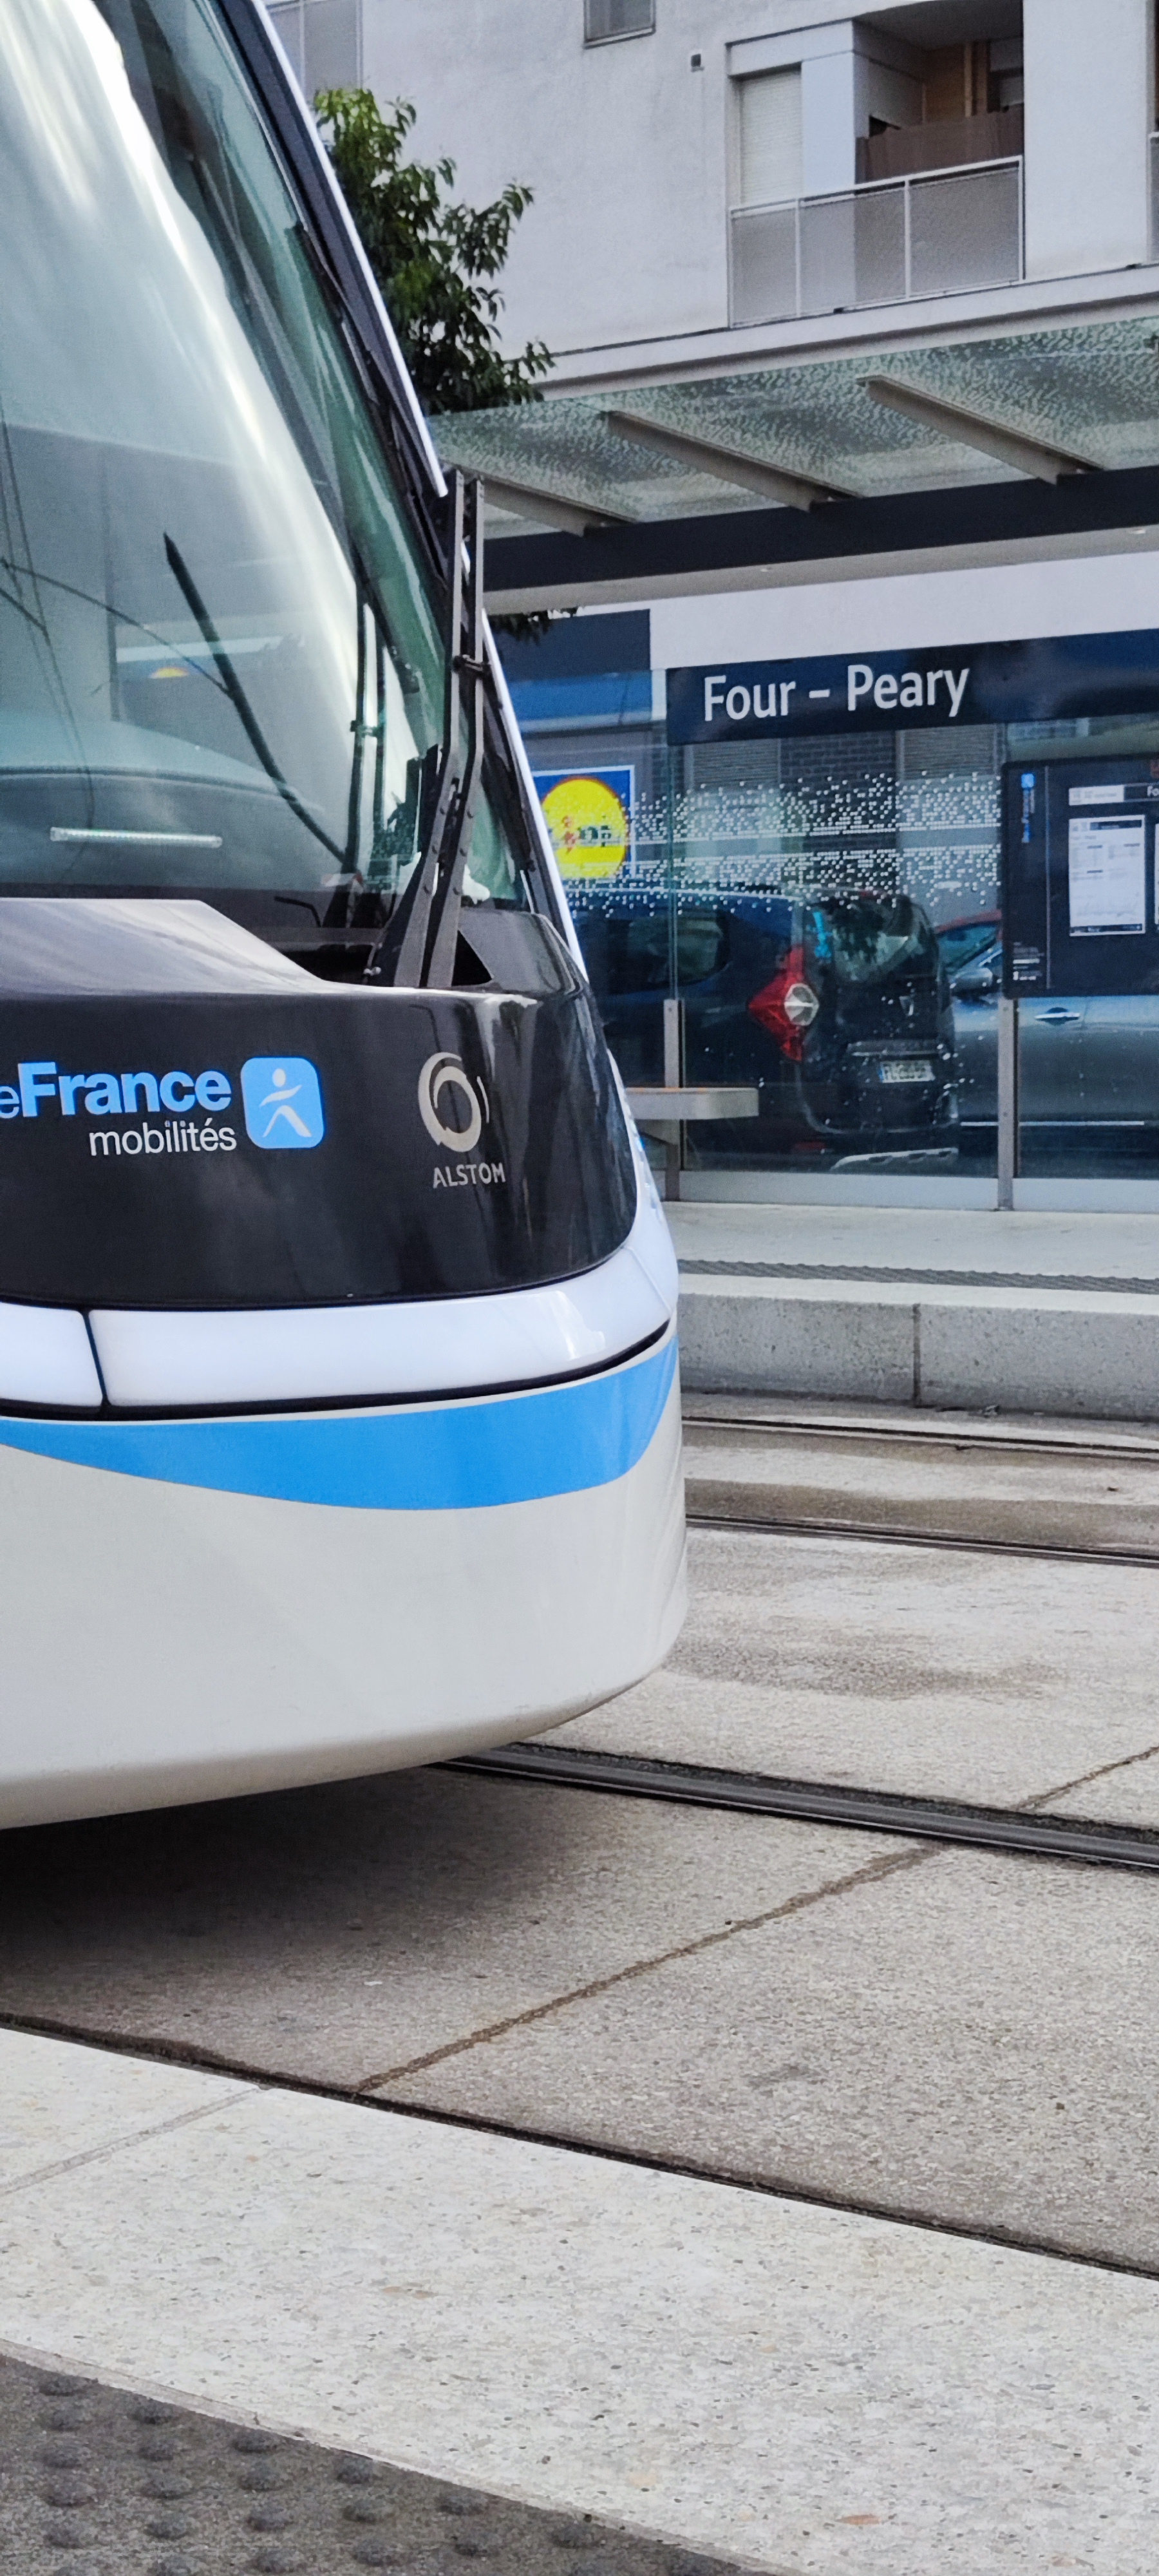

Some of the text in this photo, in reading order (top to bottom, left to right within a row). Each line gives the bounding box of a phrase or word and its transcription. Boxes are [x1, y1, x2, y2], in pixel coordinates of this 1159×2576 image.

[704, 675, 796, 722] Four
[847, 664, 969, 717] Peary
[89, 1117, 237, 1157] mobilités
[433, 1162, 505, 1189] ALSTOM
